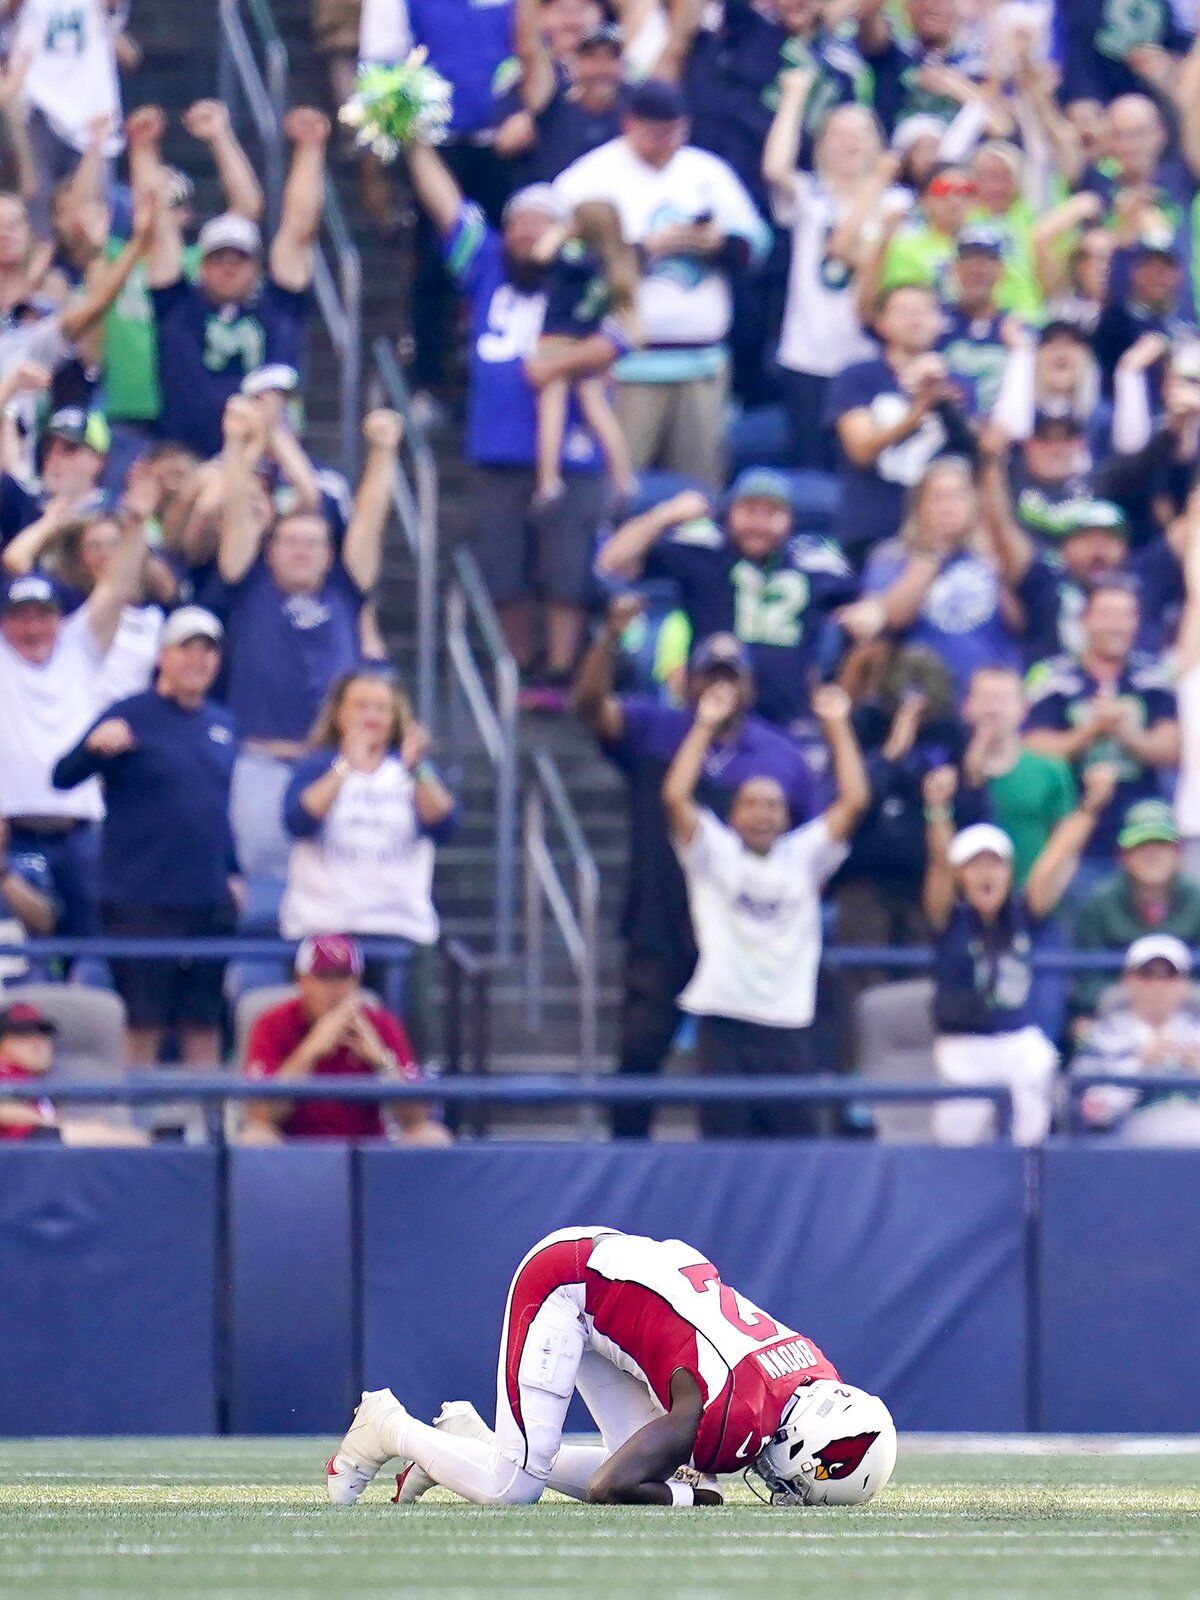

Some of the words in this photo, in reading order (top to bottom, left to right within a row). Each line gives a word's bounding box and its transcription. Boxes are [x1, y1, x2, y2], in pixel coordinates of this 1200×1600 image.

[729, 559, 811, 647] 12
[678, 1262, 779, 1342] 2
[755, 1338, 818, 1380] BROWN
